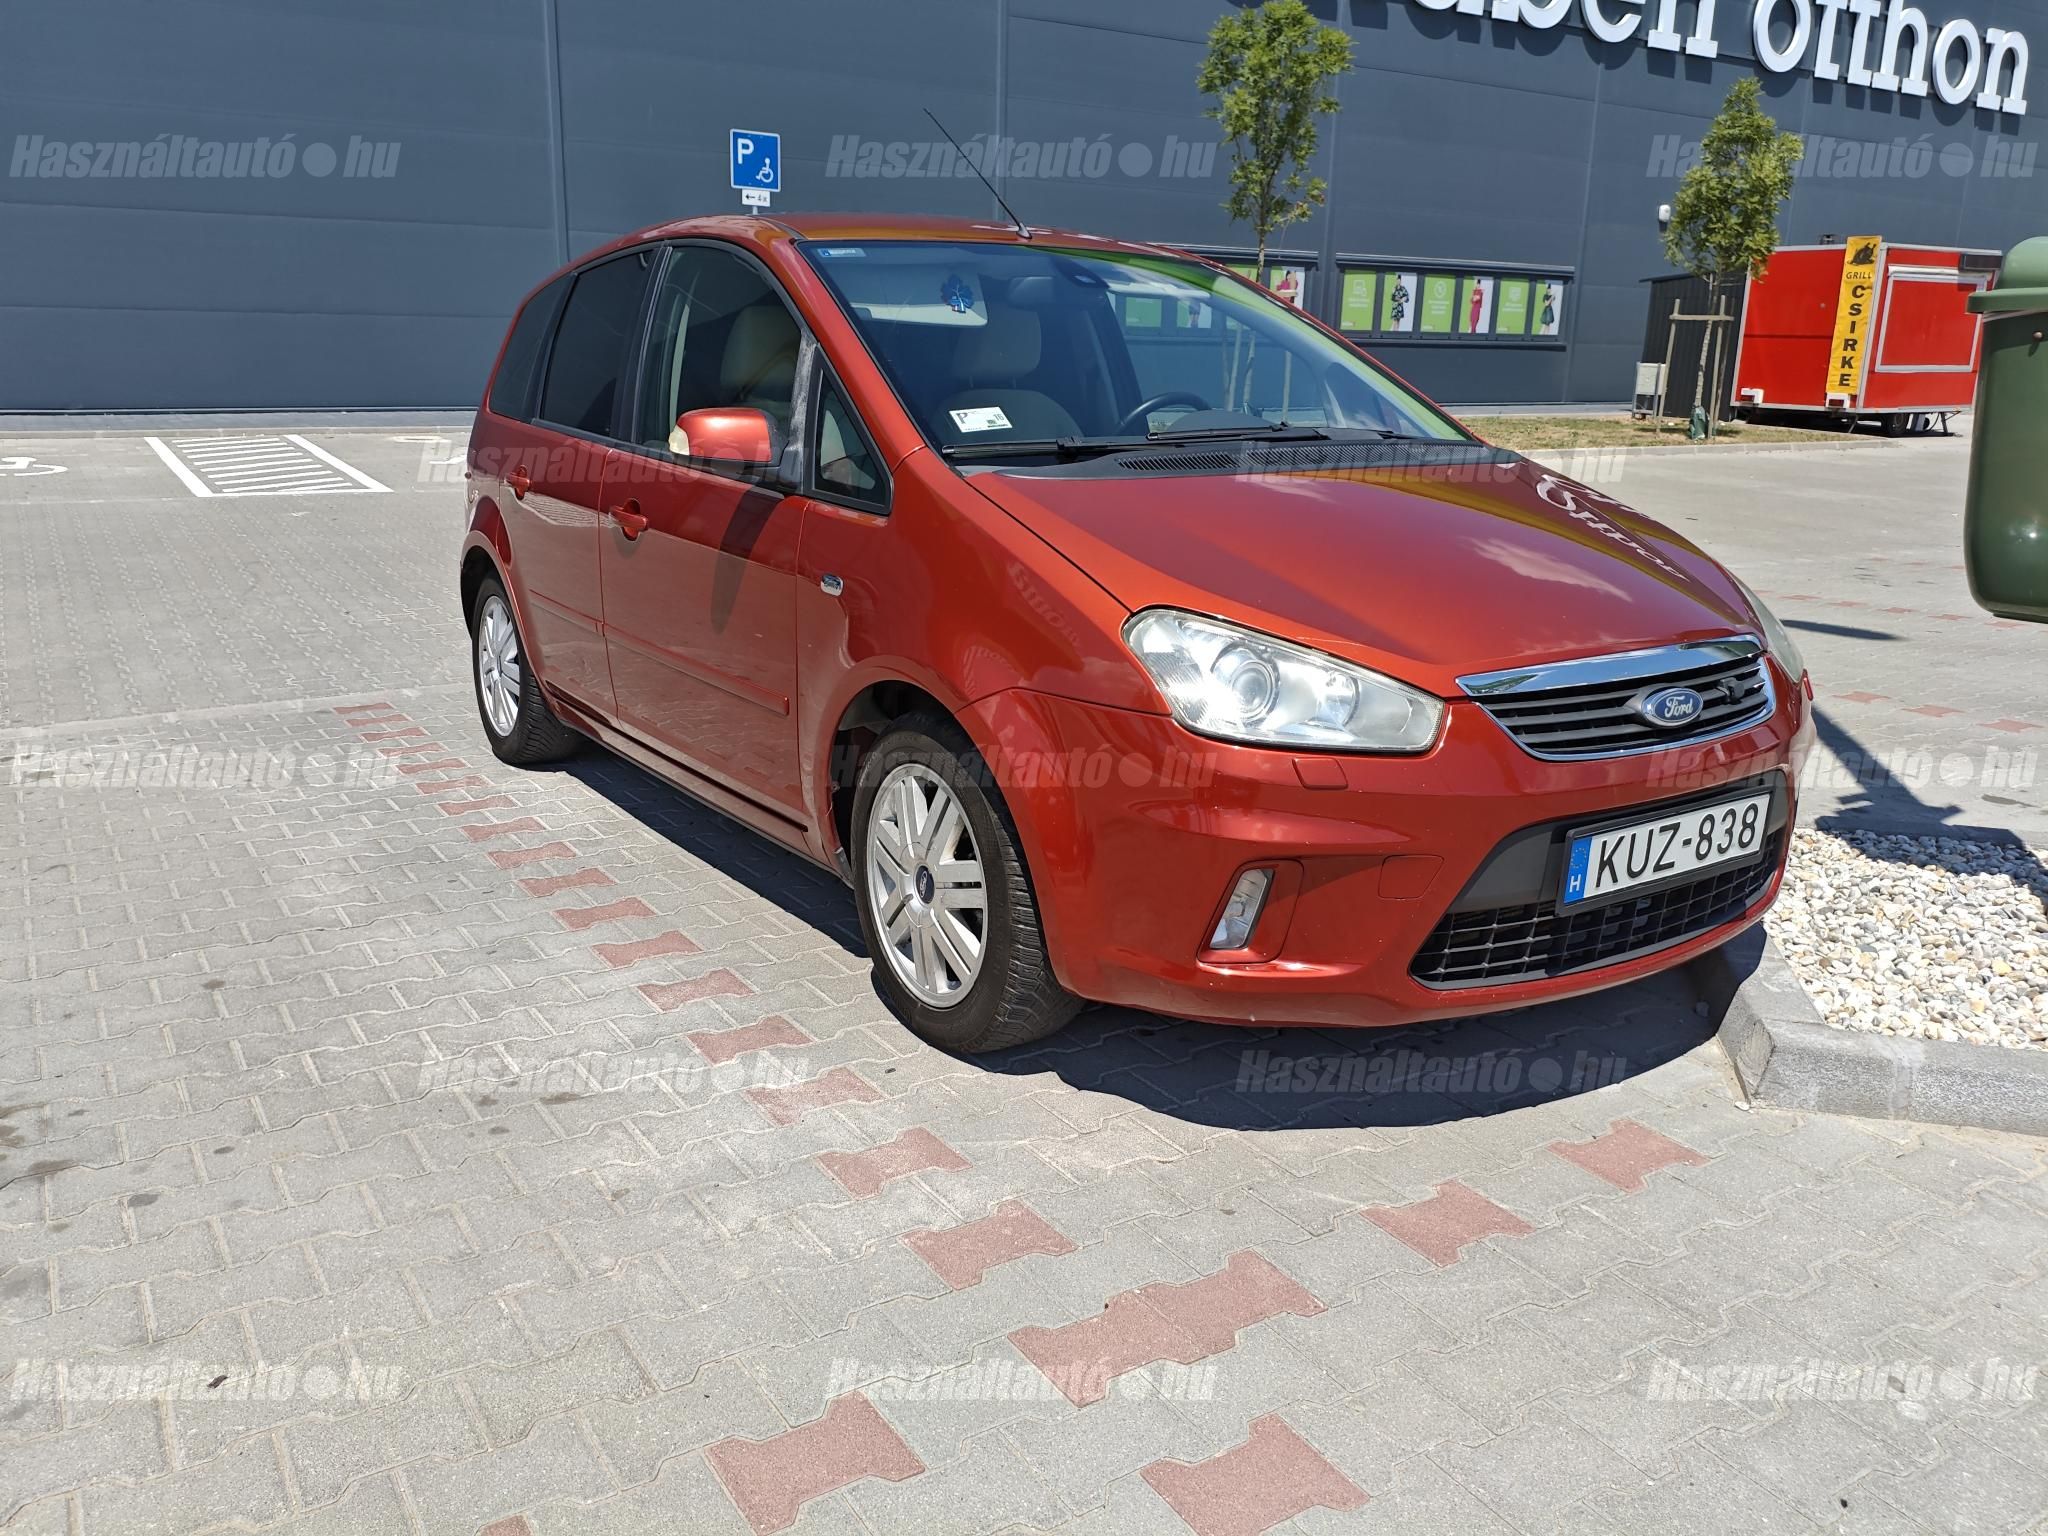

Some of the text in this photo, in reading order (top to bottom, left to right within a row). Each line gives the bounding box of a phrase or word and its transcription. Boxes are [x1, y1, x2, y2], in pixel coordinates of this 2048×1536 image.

[1753, 0, 2028, 115] otthon
[737, 138, 755, 165] P
[1845, 271, 1873, 281] GRILL
[1838, 284, 1867, 387] CSIRKE
[1664, 695, 1693, 718] Ford
[1595, 802, 1759, 888] KUZ-838
[1569, 873, 1582, 893] H
